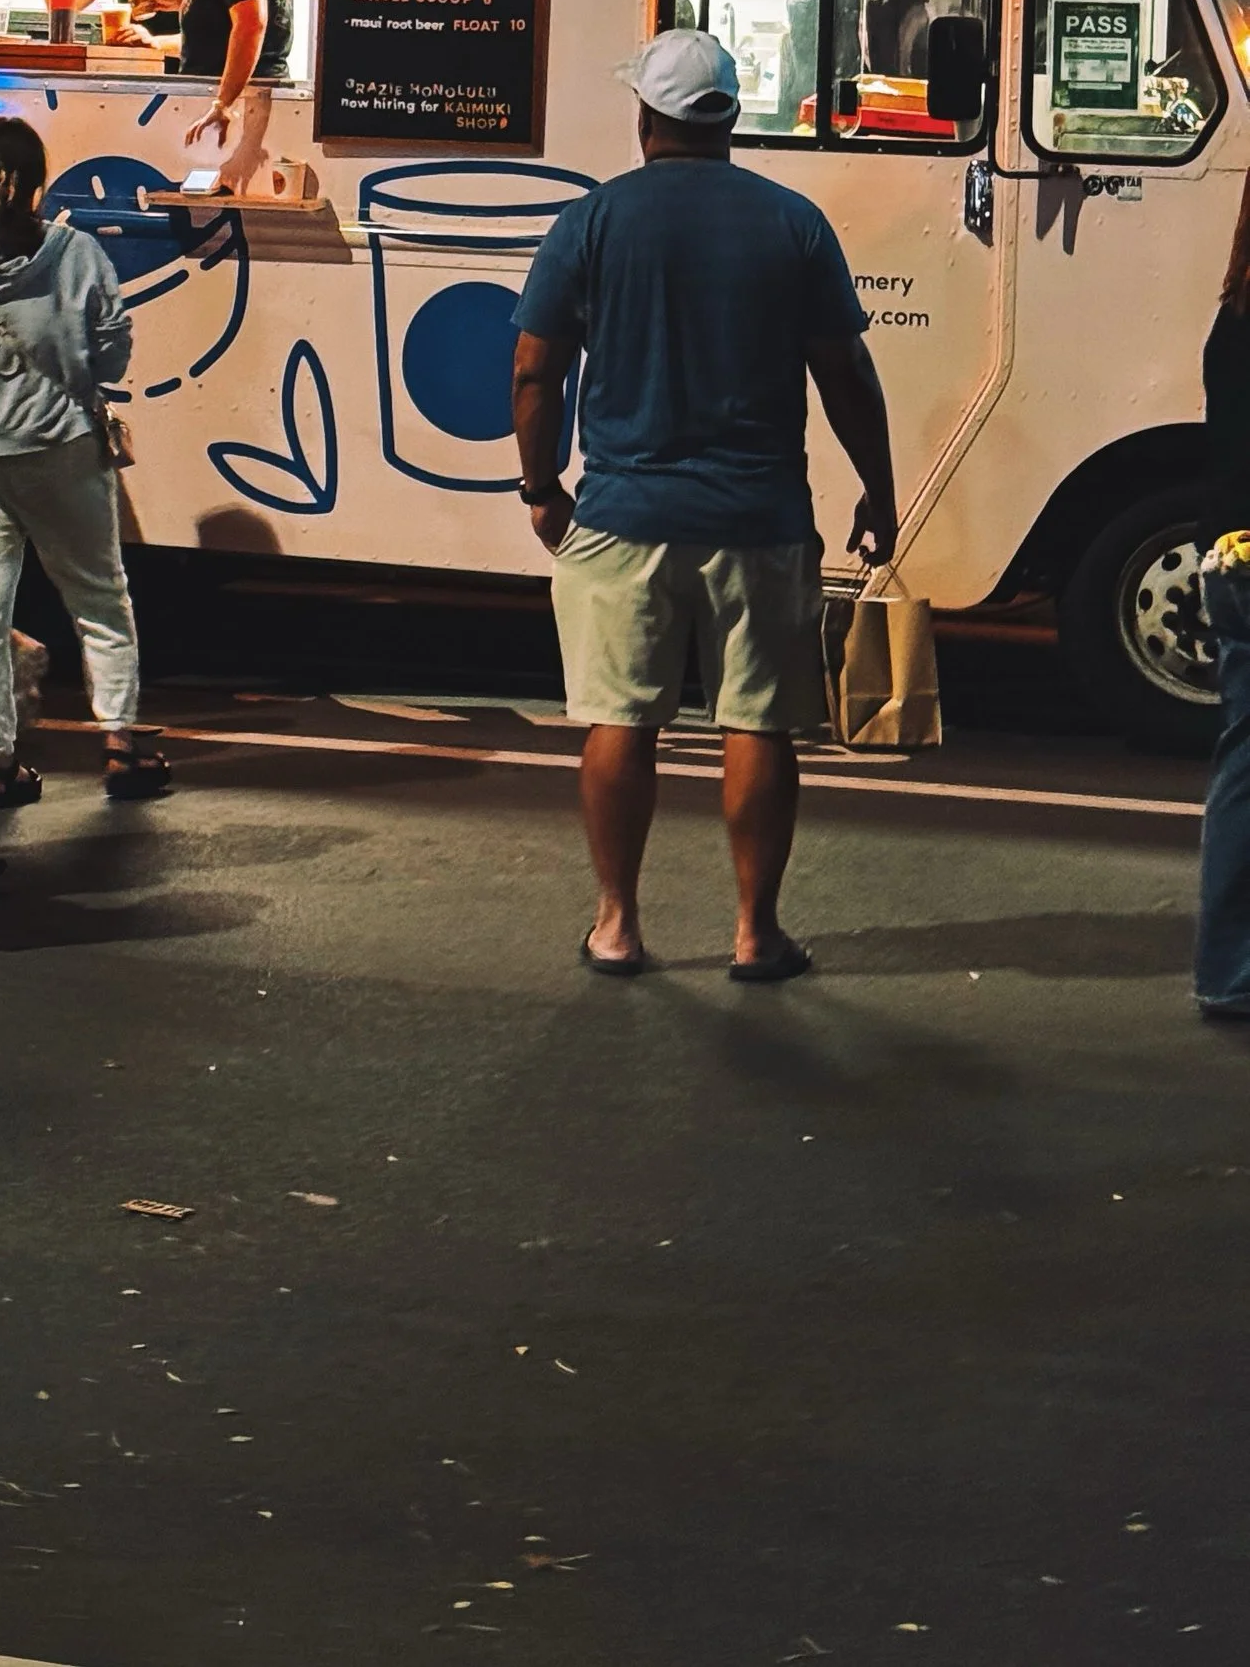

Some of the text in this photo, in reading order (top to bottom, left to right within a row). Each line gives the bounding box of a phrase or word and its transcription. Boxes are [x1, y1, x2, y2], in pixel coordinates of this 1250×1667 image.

[350, 15, 526, 32] maui root beer FLOAT 10
[1066, 15, 1128, 34] PASS
[345, 78, 497, 99] GRAZIE HONOLULU
[340, 97, 511, 115] now hiring for KAIMUKI
[456, 116, 497, 130] SHOP
[854, 275, 914, 297] mery
[861, 309, 930, 328] y.com
